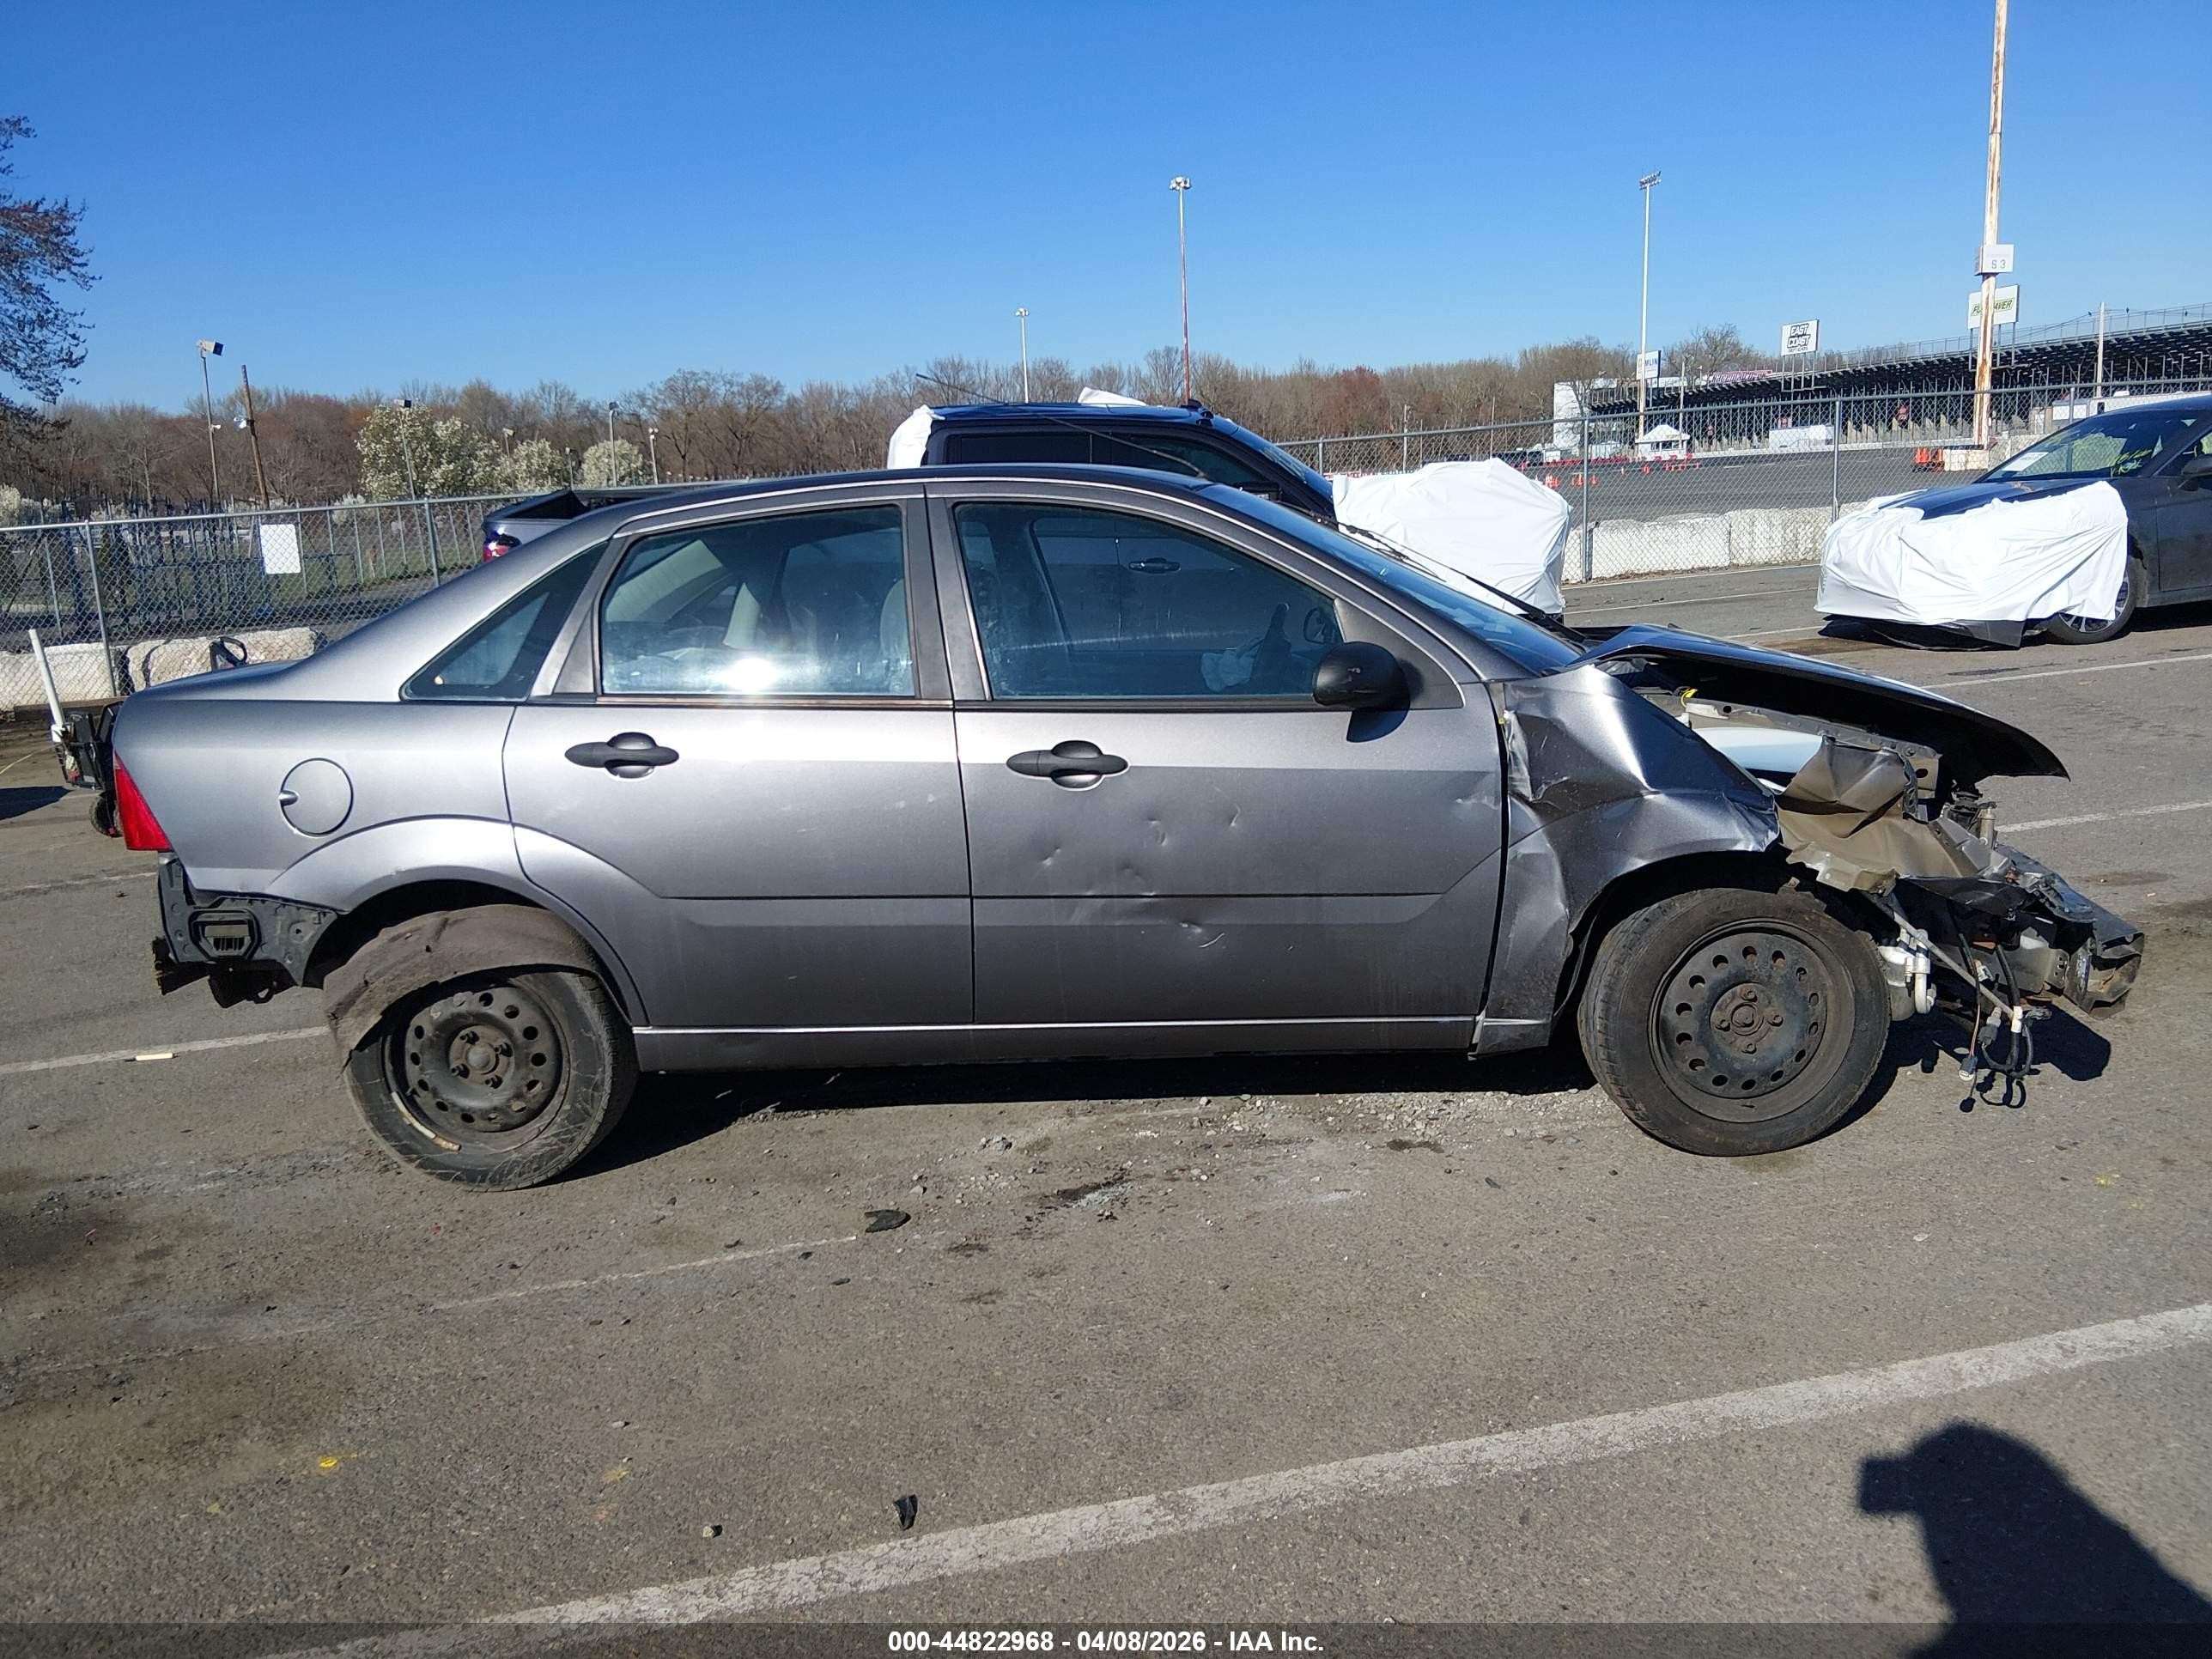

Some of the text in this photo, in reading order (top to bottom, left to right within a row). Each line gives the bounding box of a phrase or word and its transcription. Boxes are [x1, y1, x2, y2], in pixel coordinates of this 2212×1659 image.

[1972, 300, 2013, 314] FUAVER
[1790, 323, 1809, 336] EAST
[1787, 334, 1811, 349] COAST
